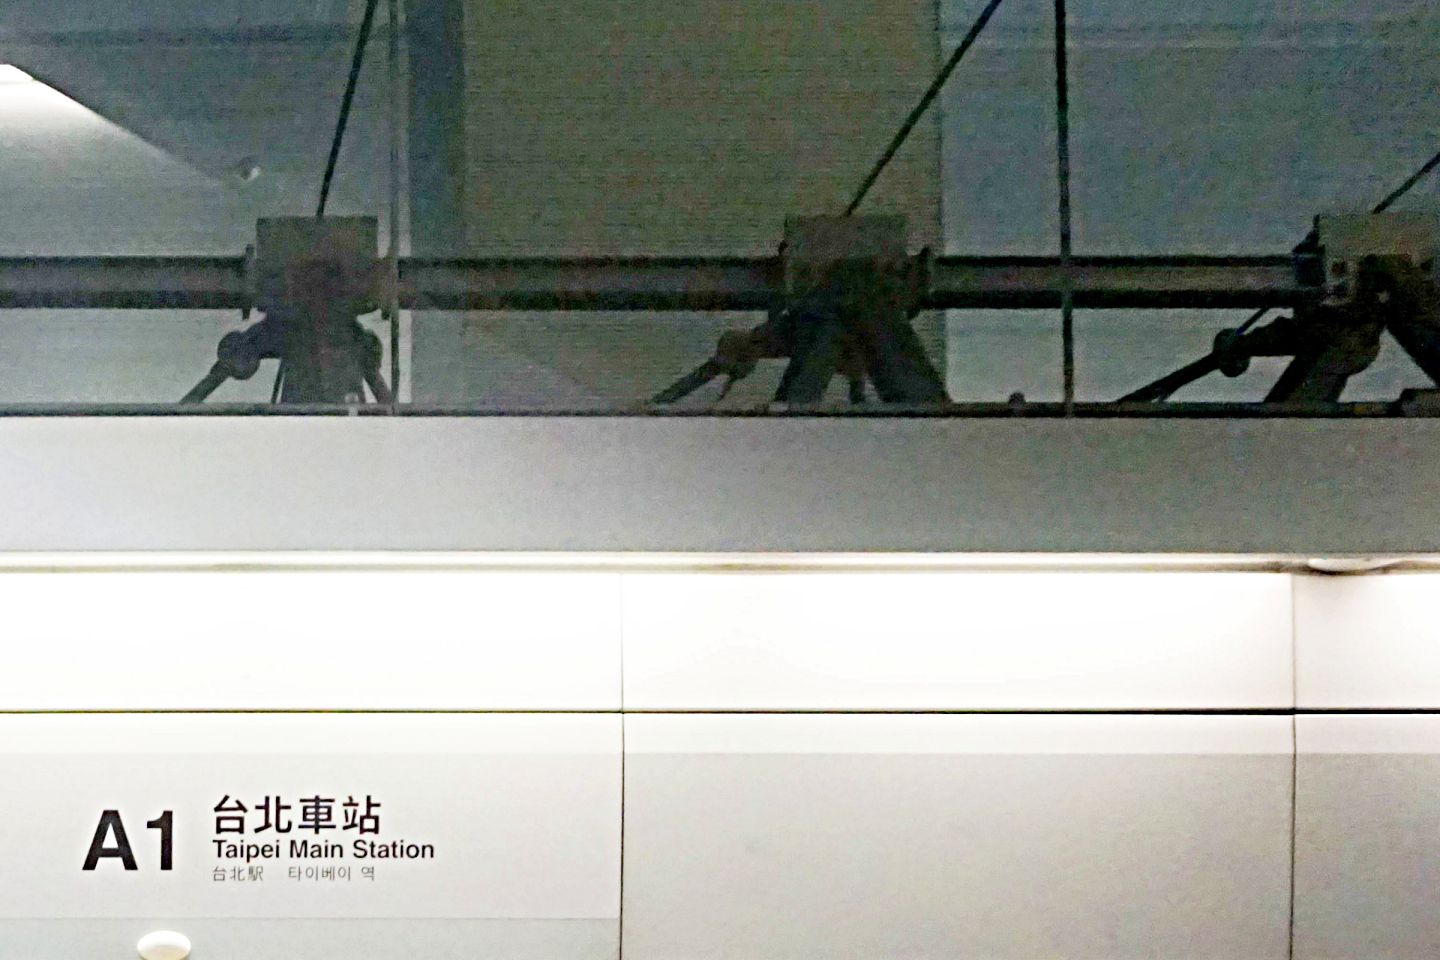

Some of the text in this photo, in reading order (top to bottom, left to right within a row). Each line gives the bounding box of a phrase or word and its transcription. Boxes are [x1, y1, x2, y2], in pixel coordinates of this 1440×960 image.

[213, 794, 382, 836] 台北車站
[81, 809, 174, 871] A1
[212, 839, 435, 864] Taipei Main Station
[360, 866, 376, 882] 역
